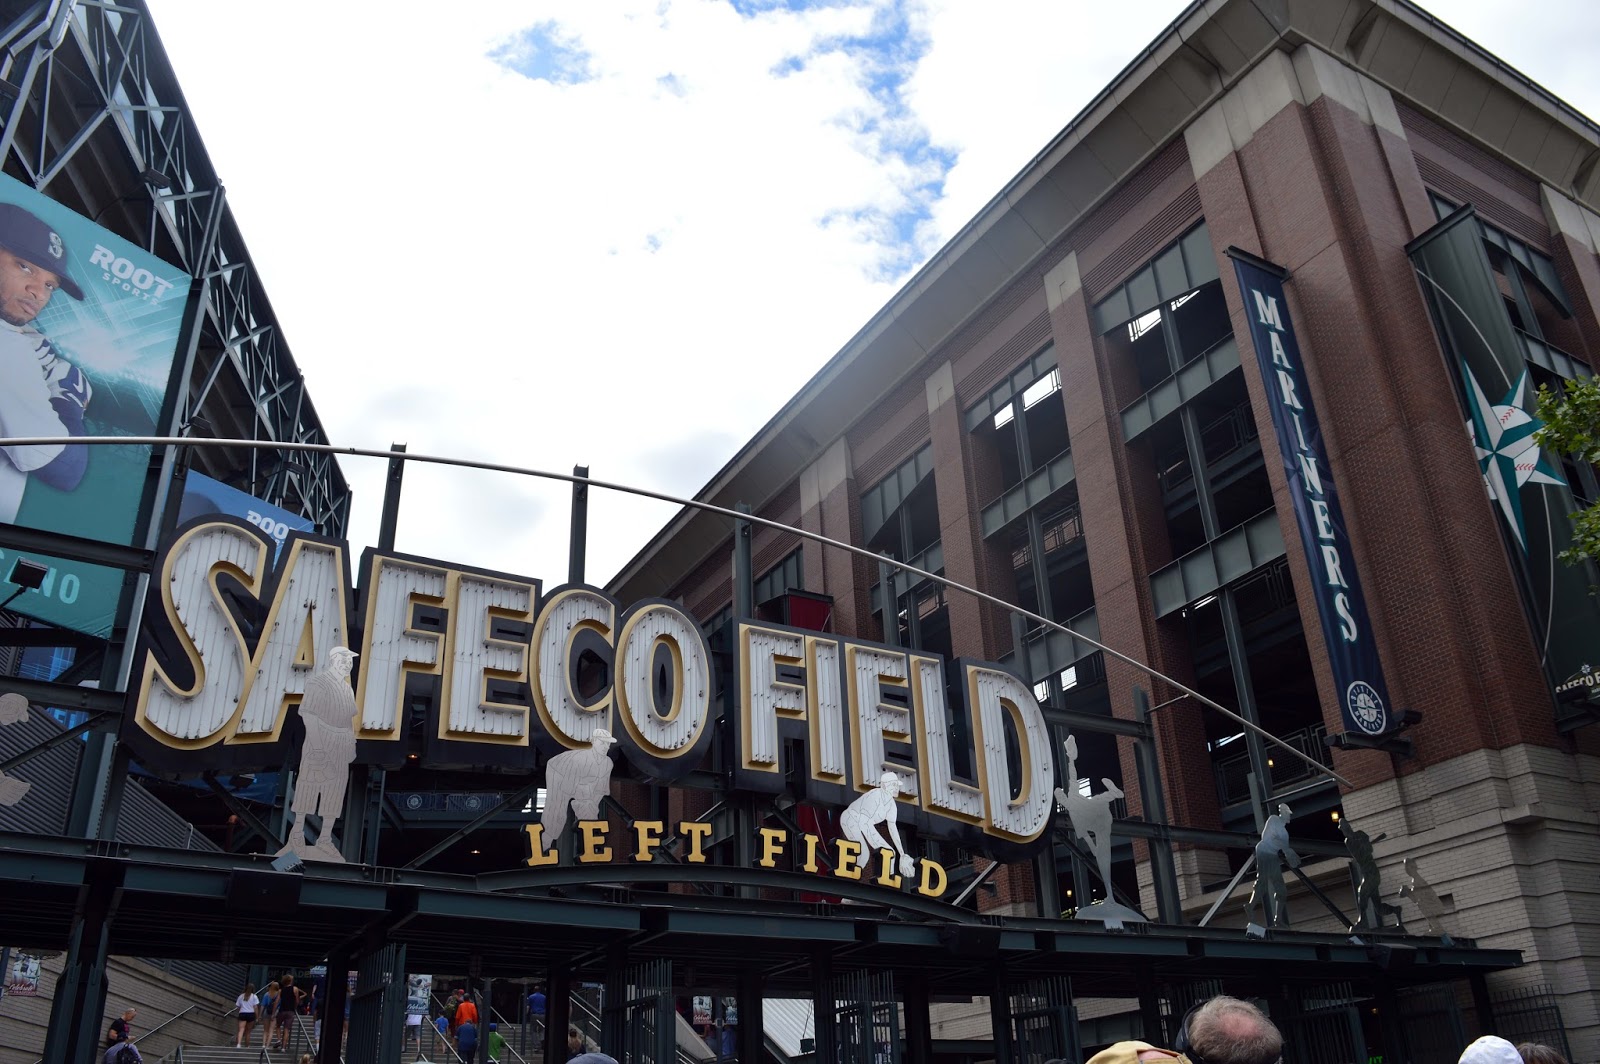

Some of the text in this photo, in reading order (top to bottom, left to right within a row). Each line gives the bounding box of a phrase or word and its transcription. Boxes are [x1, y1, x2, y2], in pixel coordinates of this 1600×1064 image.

[89, 243, 174, 299] ROOT
[102, 272, 159, 306] SPORTS
[1251, 288, 1358, 643] MARINERS
[246, 509, 298, 540] ROO
[134, 522, 1054, 844] SAFECO FIELD
[524, 820, 949, 898] LEFT FIELD
